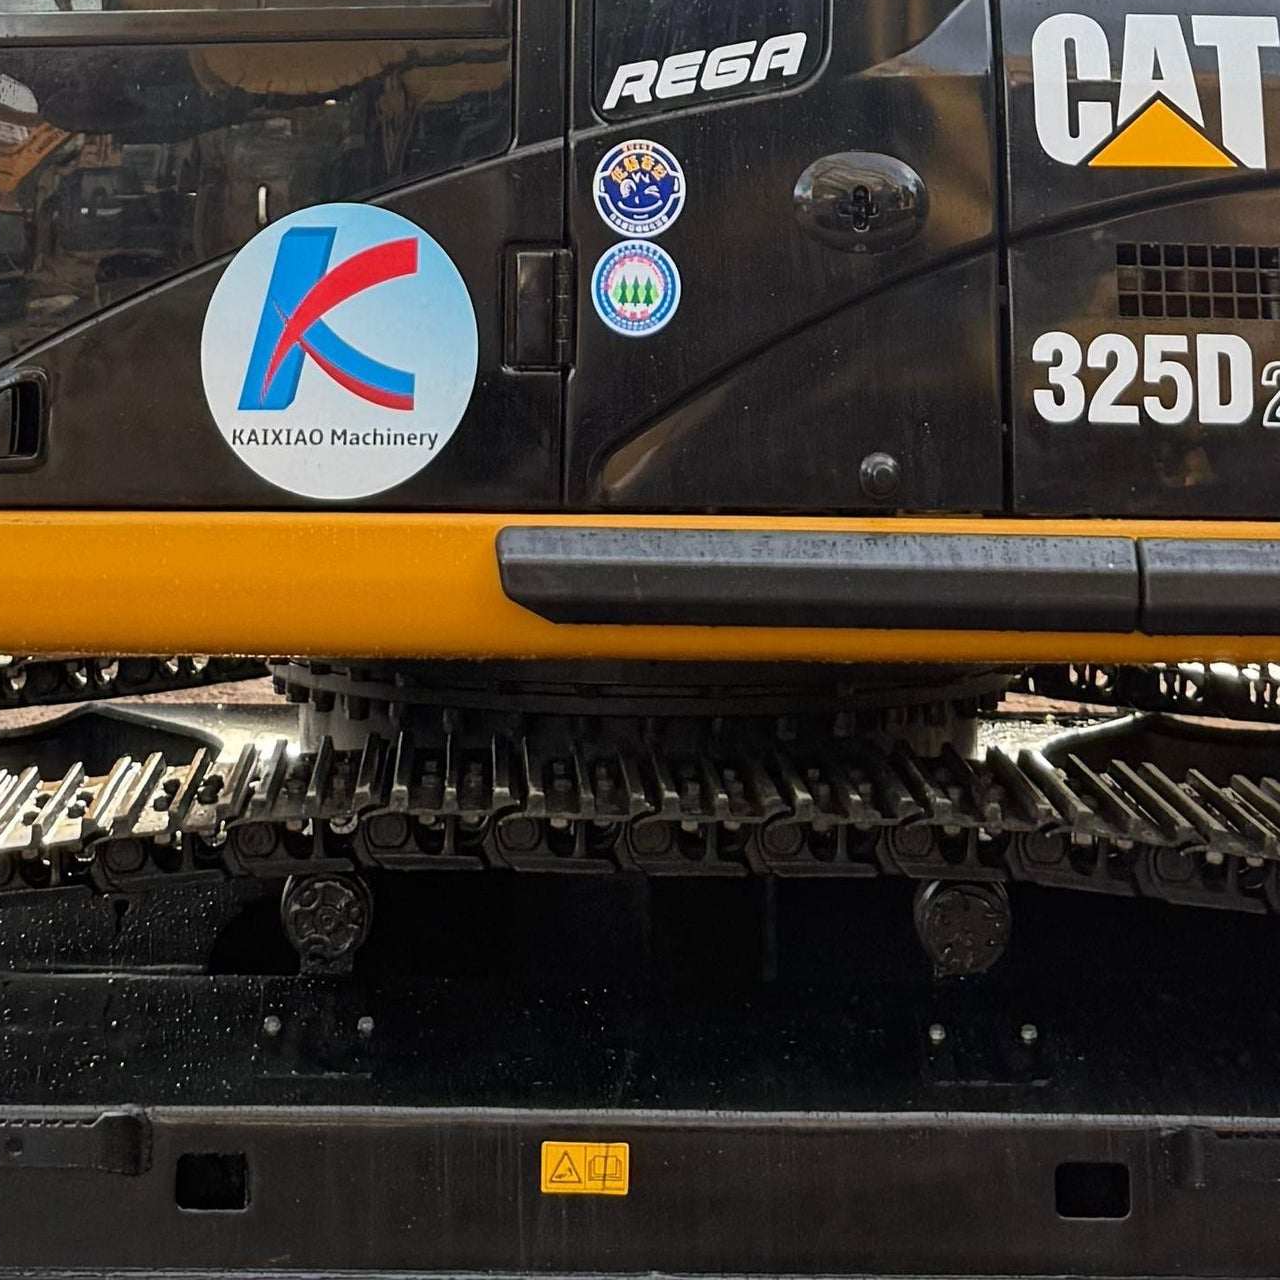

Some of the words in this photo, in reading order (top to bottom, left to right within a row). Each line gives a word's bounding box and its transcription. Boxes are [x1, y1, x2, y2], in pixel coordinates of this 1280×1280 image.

[601, 31, 808, 111] REGA
[1031, 13, 1280, 170] CAT
[1031, 331, 1255, 425] 325D
[231, 428, 324, 446] KAIXIAO
[330, 427, 438, 451] Machinery
